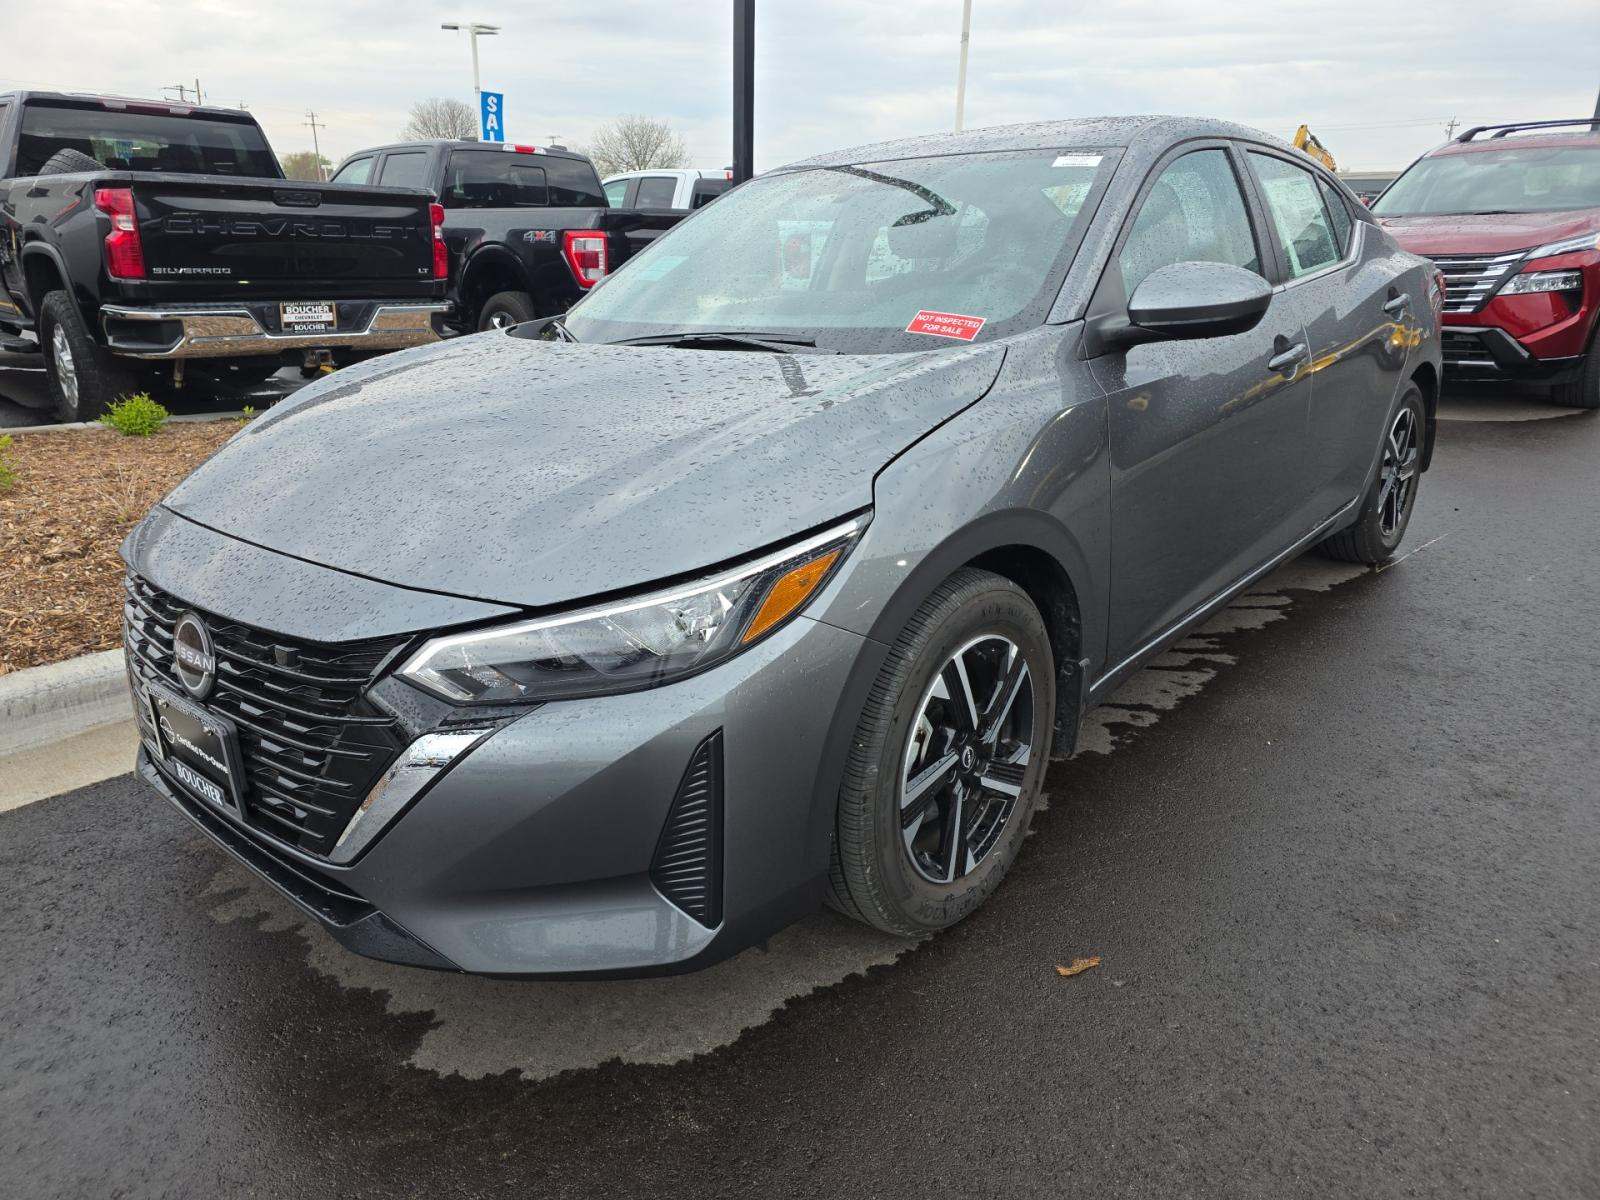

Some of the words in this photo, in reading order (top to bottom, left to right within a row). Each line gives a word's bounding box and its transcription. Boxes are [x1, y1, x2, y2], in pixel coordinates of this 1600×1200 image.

[164, 218, 416, 239] CHEVROLET
[286, 306, 329, 314] BOUCHER
[934, 316, 981, 328] INSPECTED
[922, 323, 940, 331] FOR
[940, 324, 963, 335] SALE
[175, 762, 224, 806] BOUCHER
